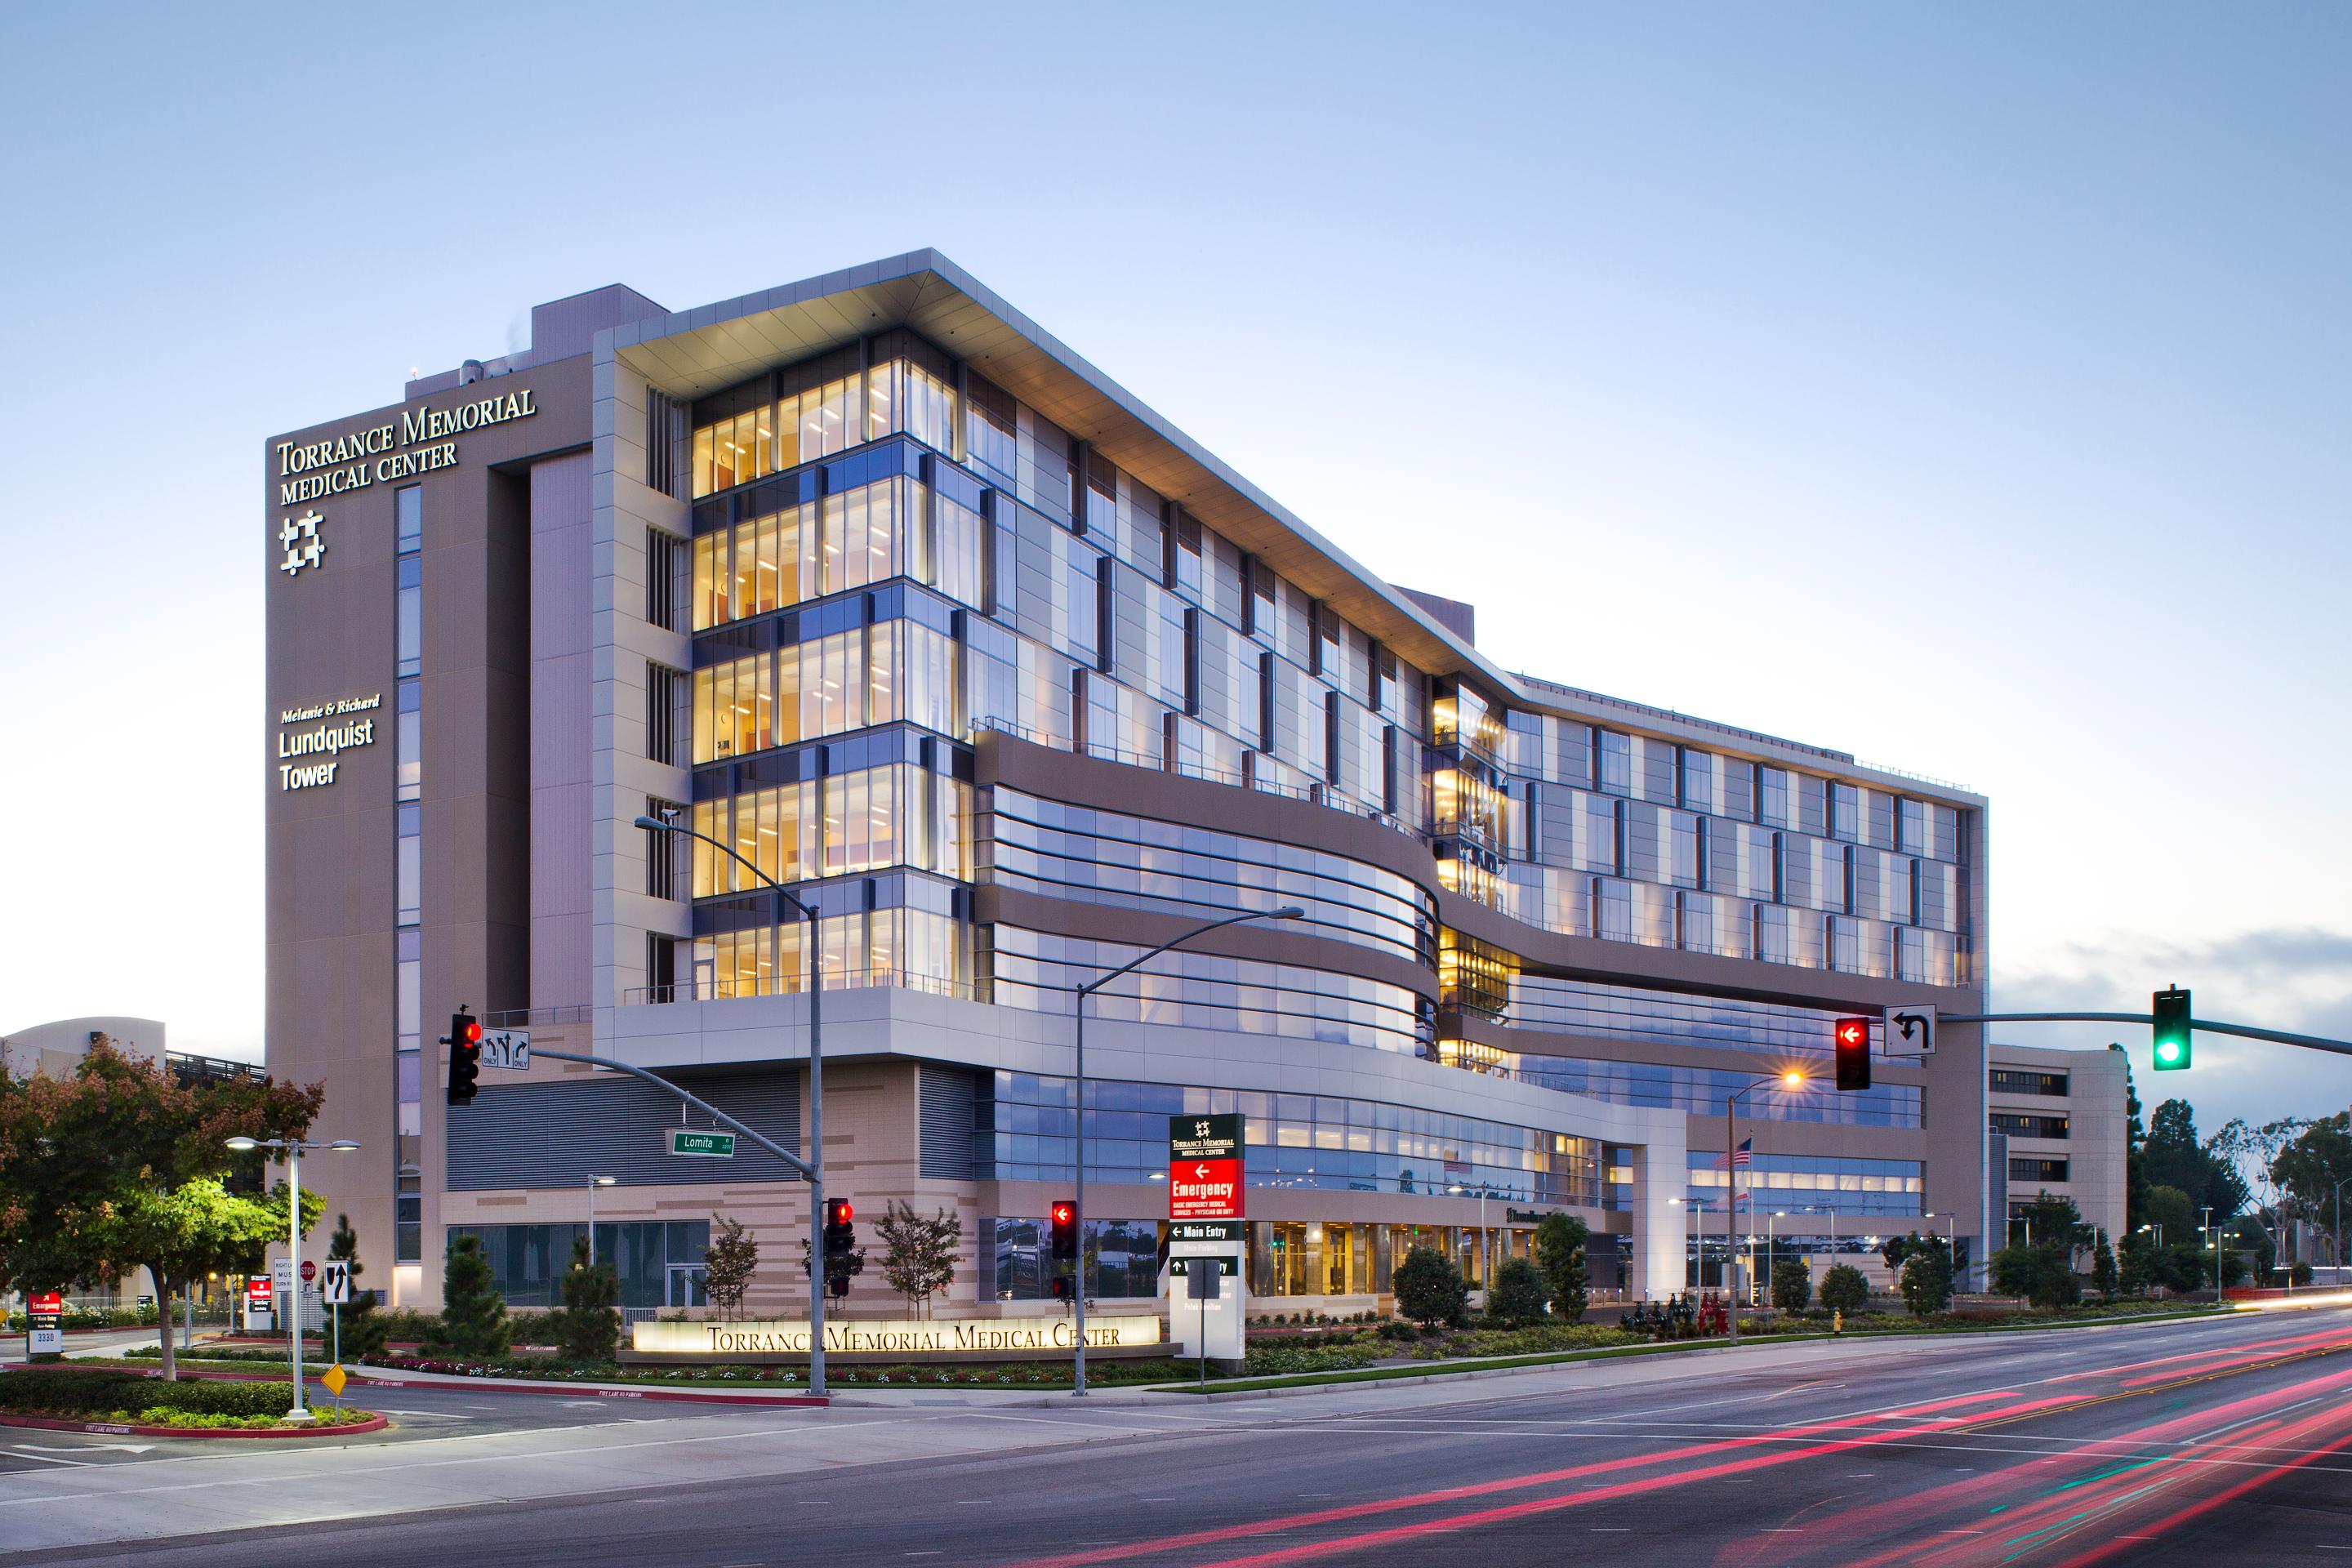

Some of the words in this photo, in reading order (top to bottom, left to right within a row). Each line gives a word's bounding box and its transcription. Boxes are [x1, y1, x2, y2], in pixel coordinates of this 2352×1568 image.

[277, 424, 394, 476] TORRANCE
[401, 389, 537, 446] MEMORIAL
[280, 463, 372, 506] MEDICAL
[376, 442, 457, 483] CENTER
[281, 706, 323, 724] Melanie
[325, 703, 336, 716] &
[337, 693, 381, 714] Richard
[279, 719, 374, 759] Lundquist
[279, 762, 337, 791] Tower
[684, 1136, 713, 1148] Lomita
[1173, 1140, 1201, 1148] TORRANCE
[1203, 1138, 1234, 1147] MEMORIAL
[1173, 1180, 1234, 1200] Emergency
[1183, 1226, 1204, 1238] Main
[1205, 1225, 1227, 1240] Entry
[301, 1267, 315, 1276] STOP
[33, 1302, 60, 1311] Emergency
[38, 1333, 55, 1342] 3330
[826, 1326, 946, 1352] MEMORIAL
[954, 1325, 1047, 1350] MEDICAL
